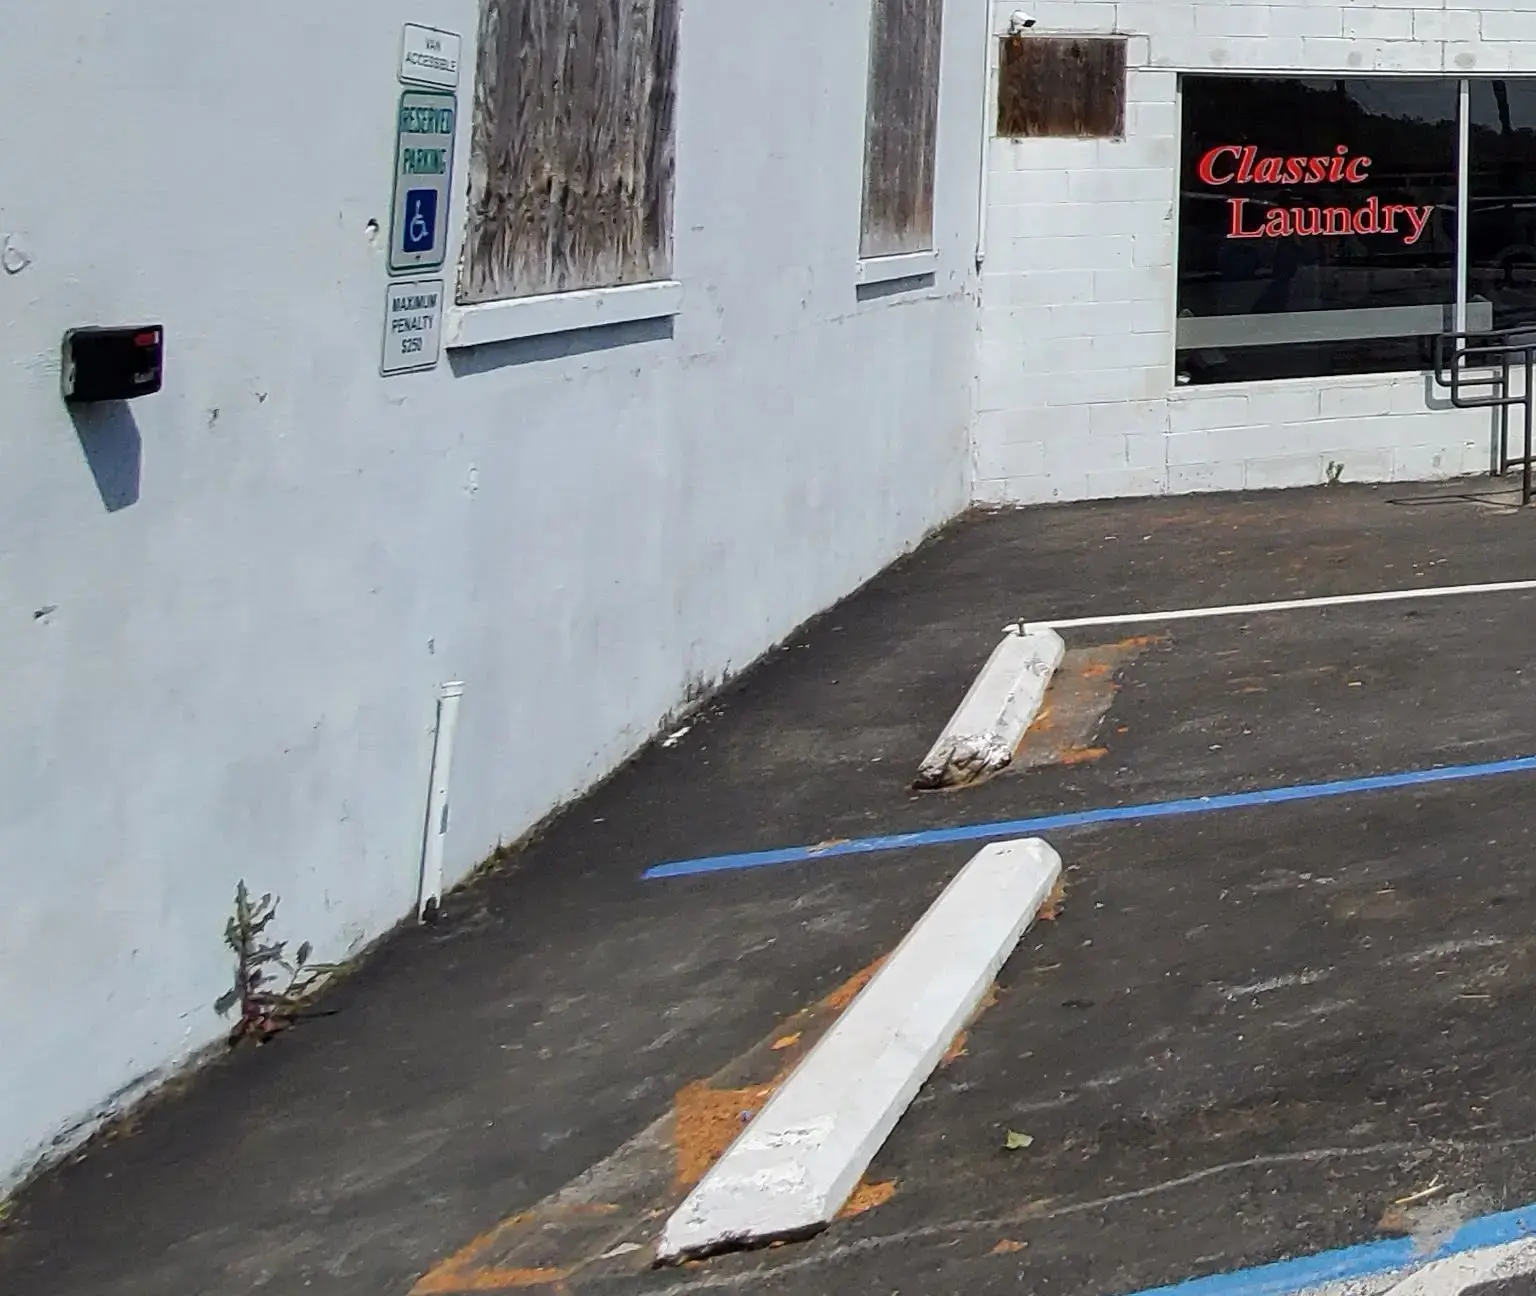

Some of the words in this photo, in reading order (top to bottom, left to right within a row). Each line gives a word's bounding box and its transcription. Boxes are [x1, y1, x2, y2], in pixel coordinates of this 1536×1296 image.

[401, 107, 453, 134] RESERVED
[403, 148, 447, 174] PARKING
[1198, 144, 1373, 186] Classic
[1227, 196, 1434, 245] Laundry
[392, 293, 437, 312] MAXIMUM
[391, 315, 434, 334] PENALTY
